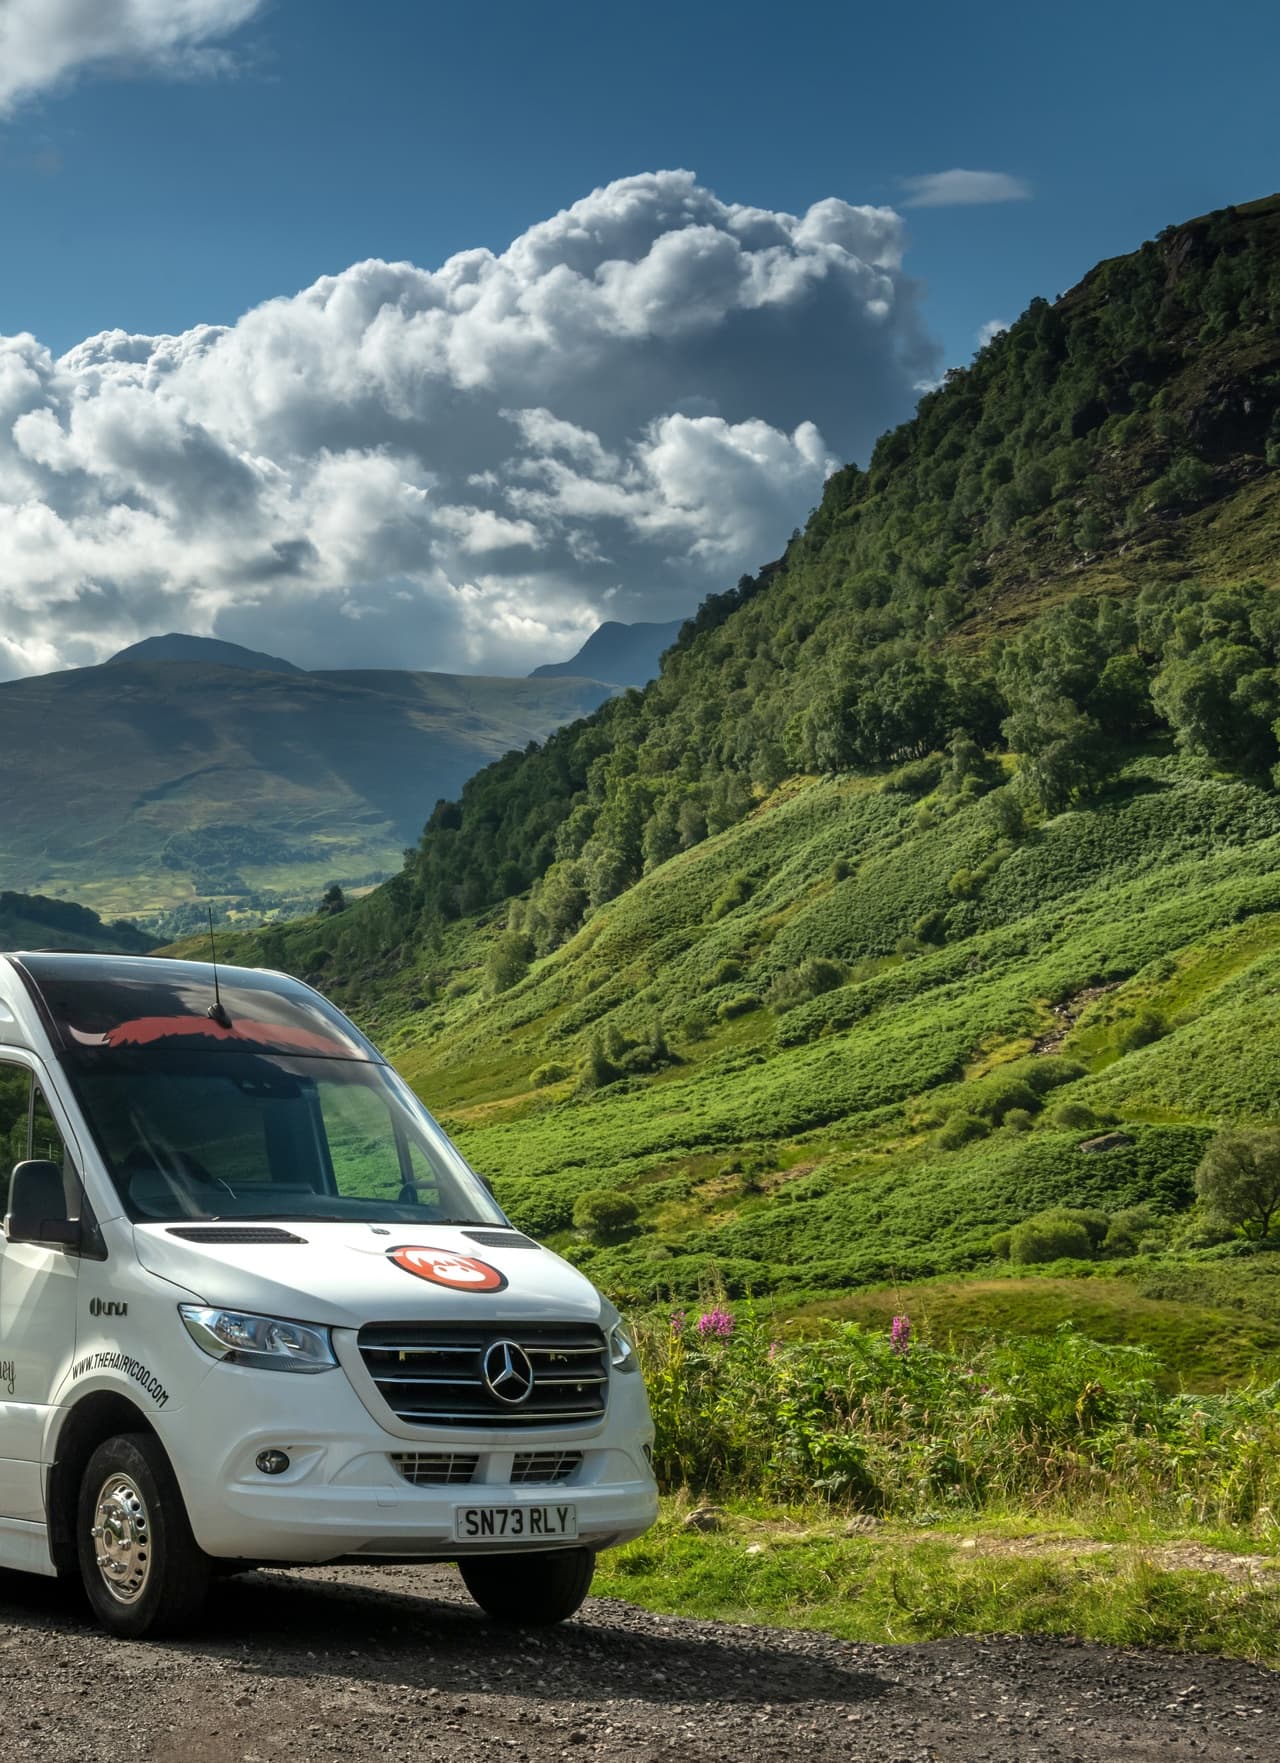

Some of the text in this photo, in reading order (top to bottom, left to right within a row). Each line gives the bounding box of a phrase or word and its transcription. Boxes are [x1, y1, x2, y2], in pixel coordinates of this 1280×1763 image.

[72, 1351, 169, 1408] WWW.THEHAIRYCOO.COM
[465, 1507, 568, 1535] SN73 RLY
